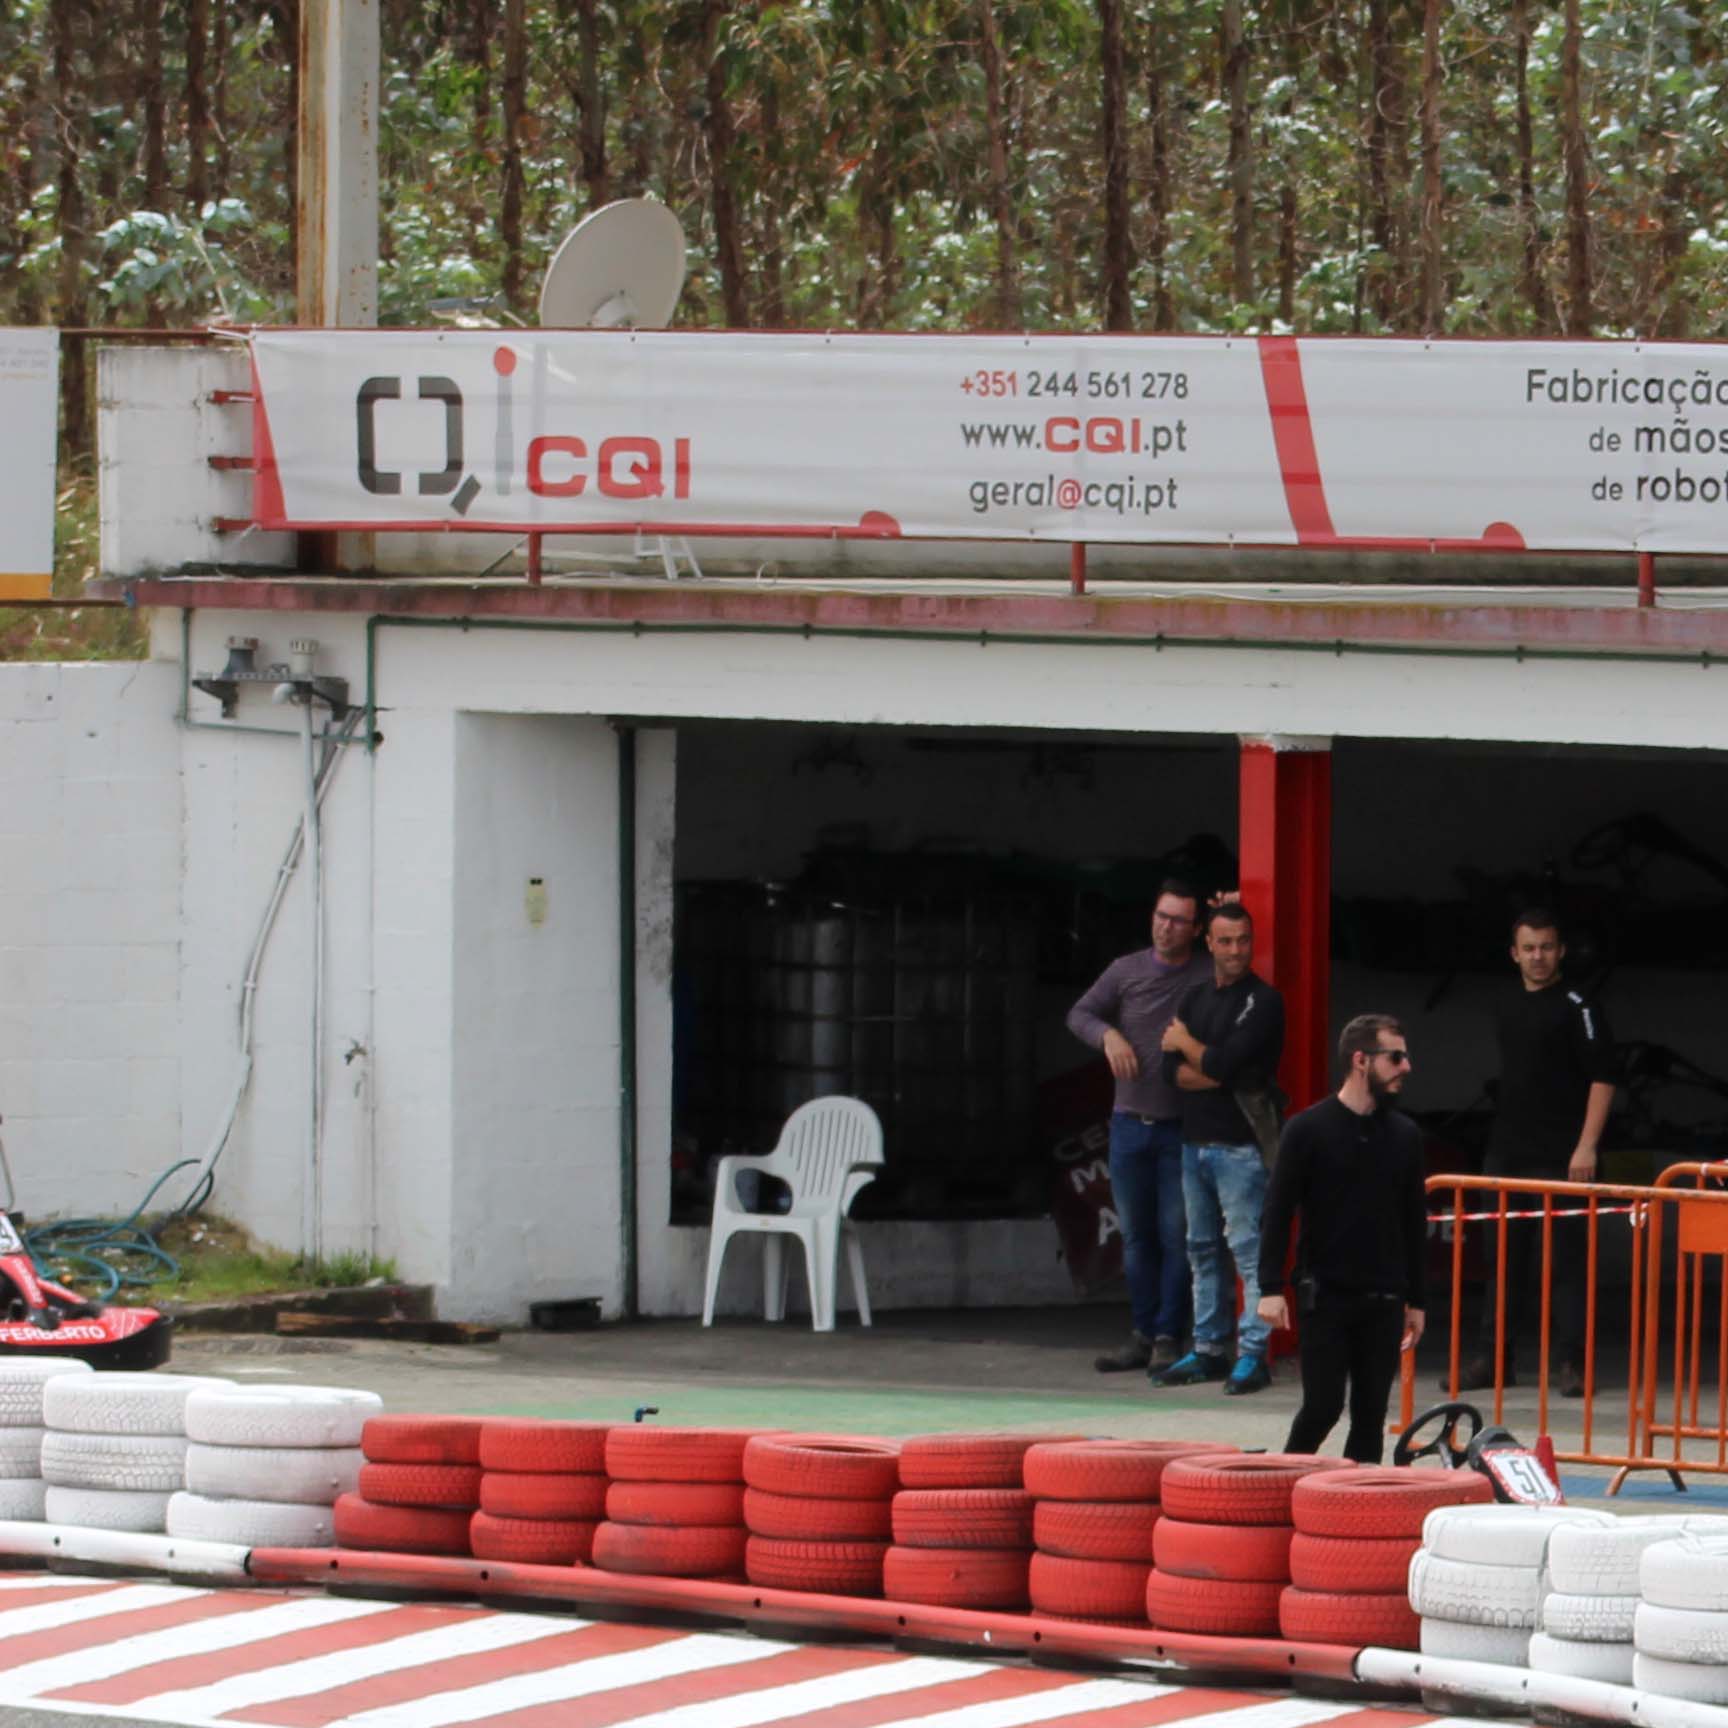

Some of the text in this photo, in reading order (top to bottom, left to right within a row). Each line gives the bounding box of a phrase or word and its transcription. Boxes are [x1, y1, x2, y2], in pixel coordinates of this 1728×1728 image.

[959, 370, 1189, 399] +351 244 561 278
[960, 416, 1188, 459] www.CQI.pt
[1588, 426, 1622, 453] de
[526, 435, 691, 499] CQI
[968, 474, 1178, 515] geral@cqi.pt
[1590, 475, 1623, 502] de
